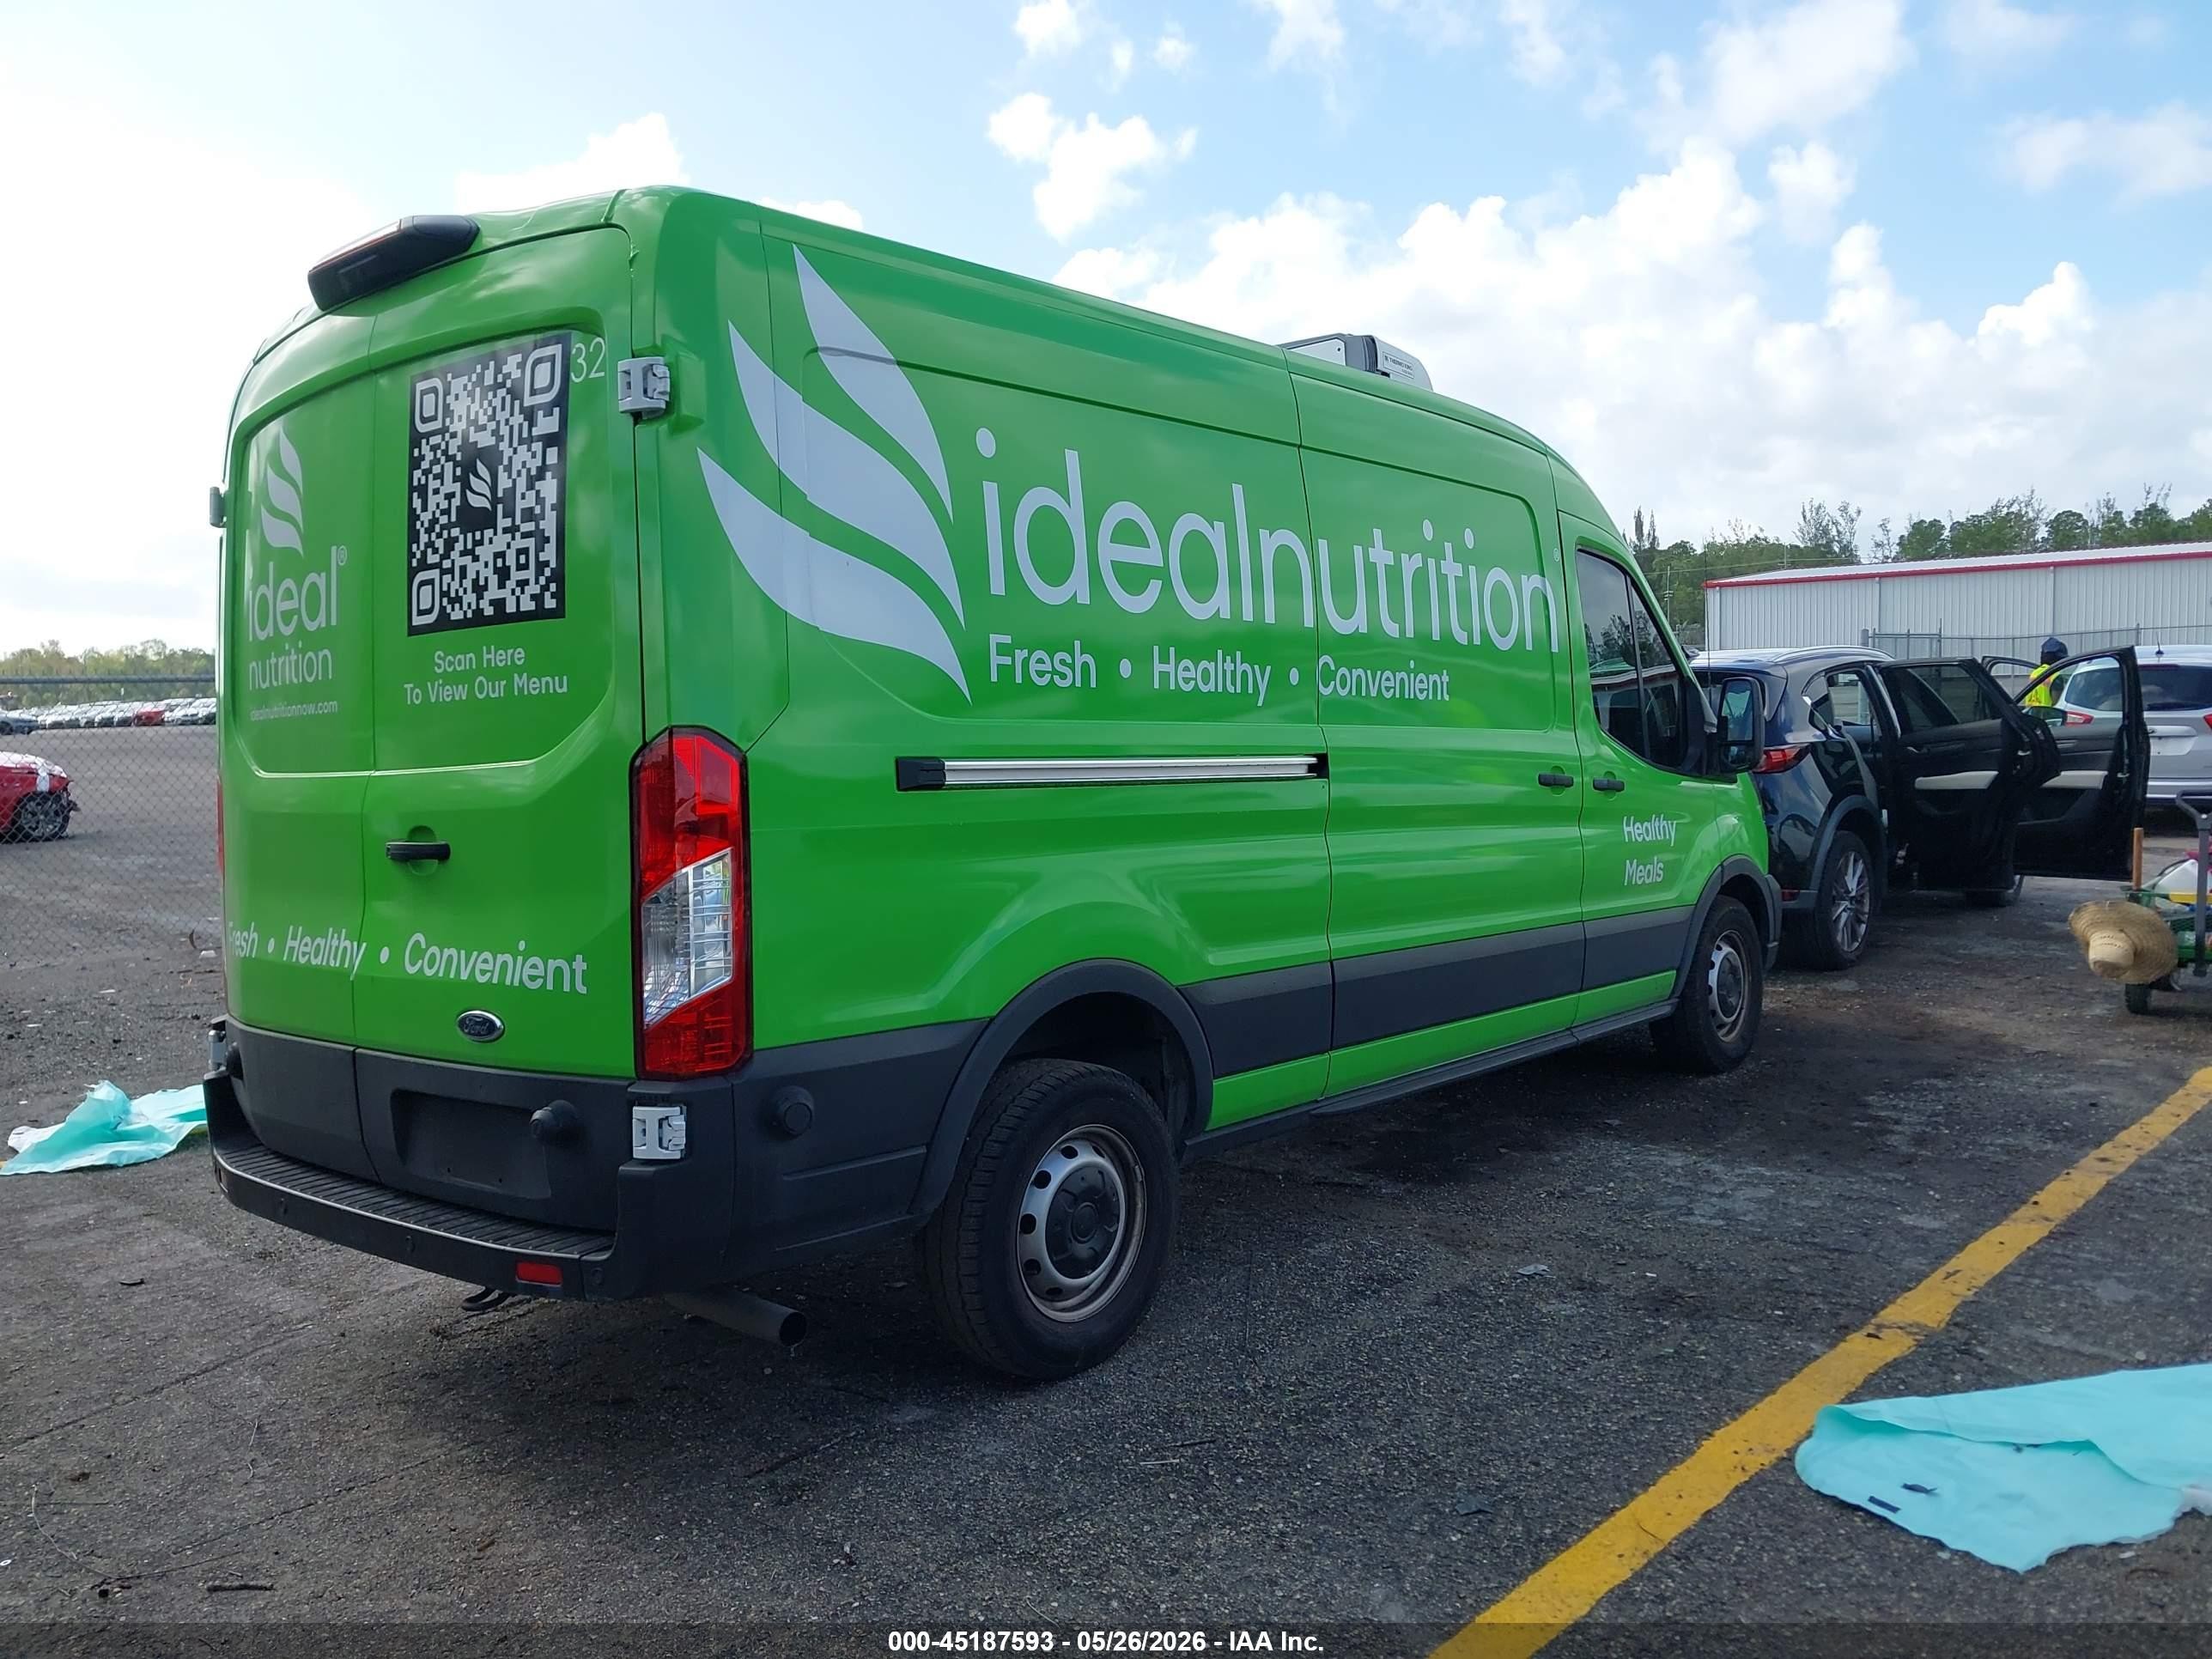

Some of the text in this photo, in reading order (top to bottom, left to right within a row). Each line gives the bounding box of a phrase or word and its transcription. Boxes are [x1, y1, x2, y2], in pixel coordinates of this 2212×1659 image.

[571, 337, 605, 383] 32
[975, 427, 1559, 653] idealnutrition
[249, 641, 332, 690] nutrition
[434, 645, 526, 673] Scan Here
[989, 634, 1450, 707] Fresh Healthy Convenient
[404, 672, 568, 705] To View Our Menu
[1622, 814, 1677, 847] Healthy
[1624, 856, 1664, 886] Meals
[283, 925, 368, 981] Healthy
[404, 933, 588, 994] Convenient
